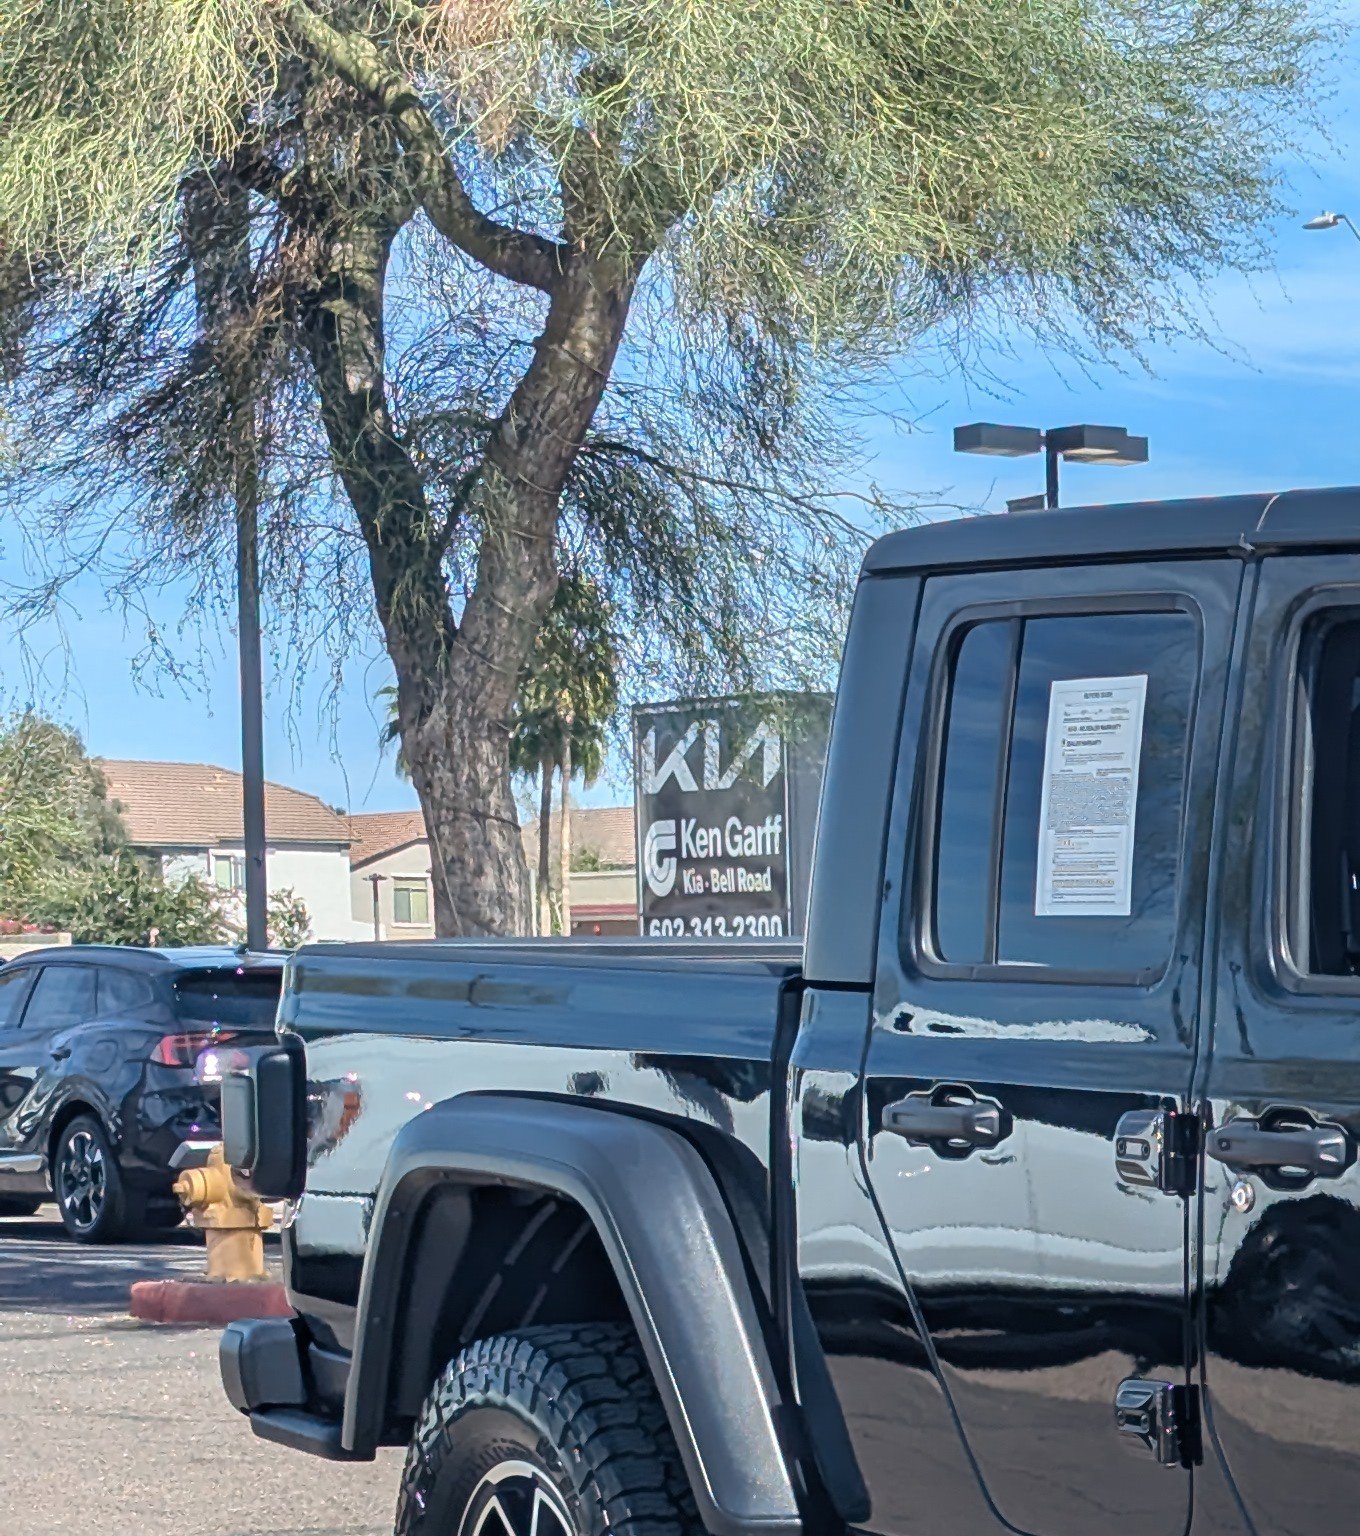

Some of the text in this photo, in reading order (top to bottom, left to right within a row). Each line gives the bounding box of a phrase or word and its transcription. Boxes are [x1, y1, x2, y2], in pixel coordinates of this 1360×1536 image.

[681, 814, 782, 859] Ken Garff
[682, 865, 772, 895] Kia Bell Road
